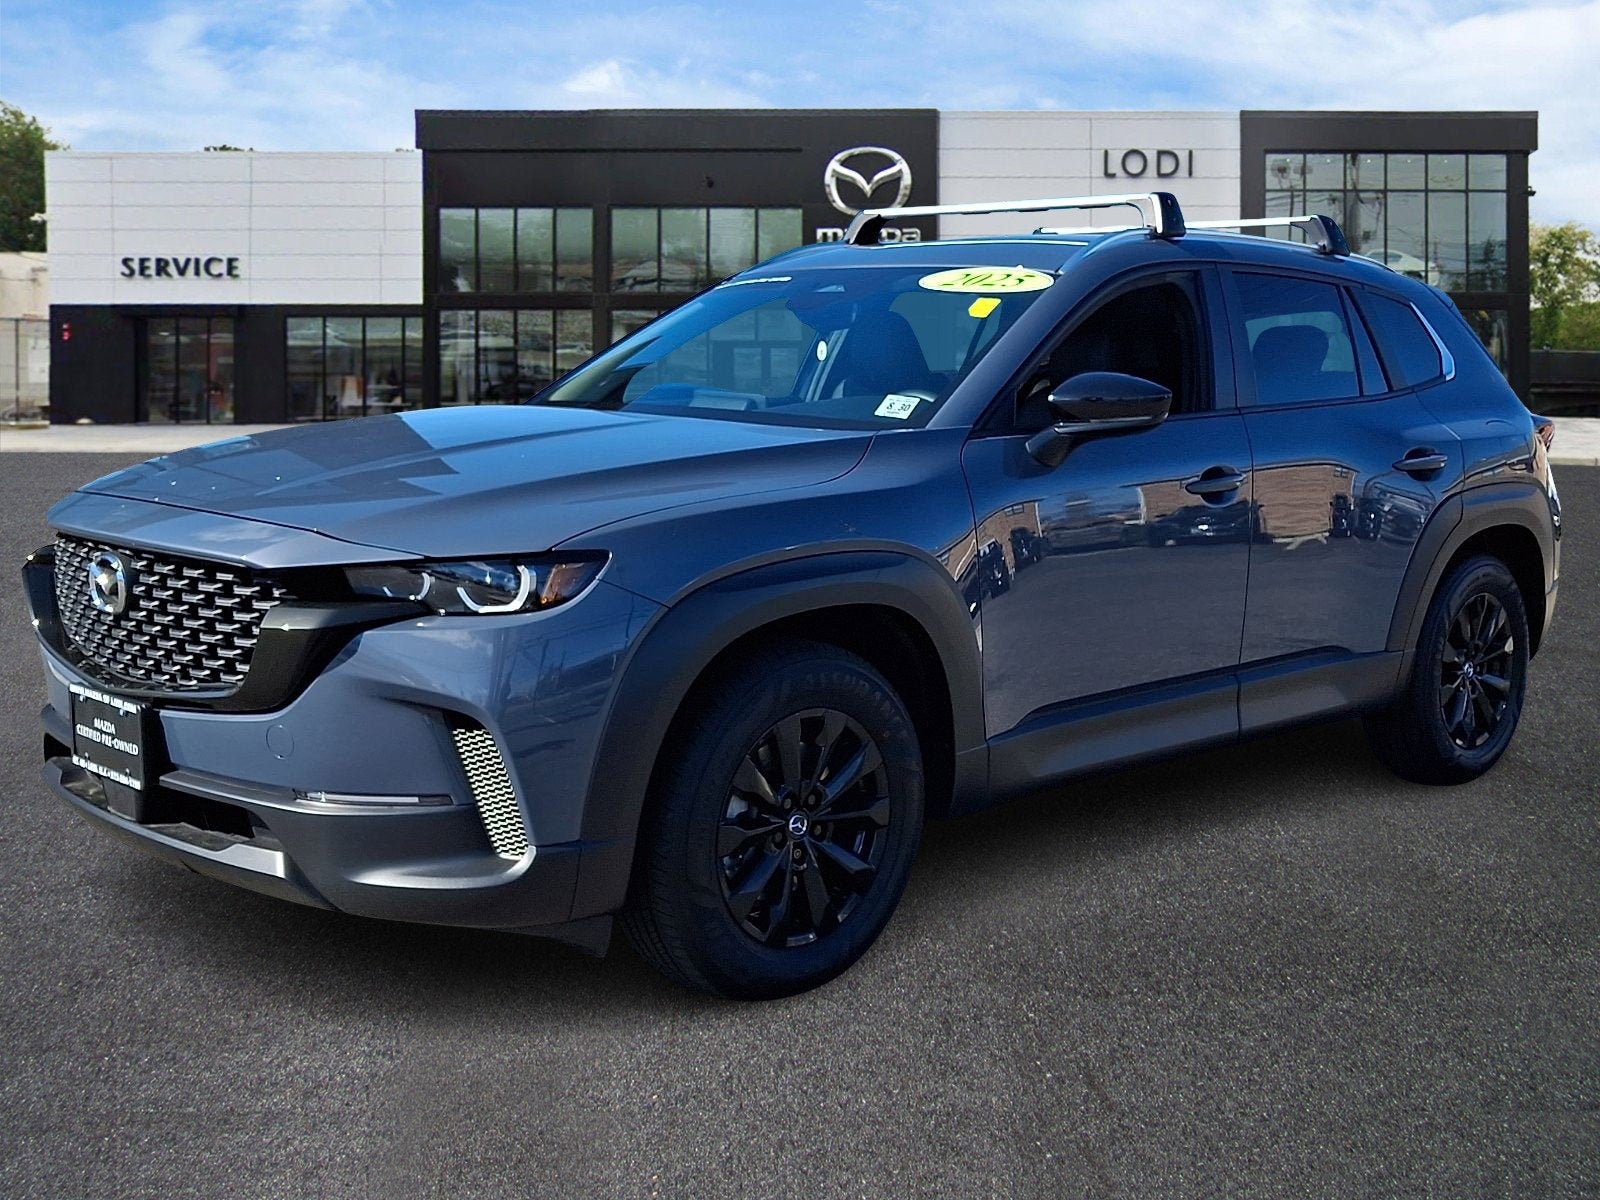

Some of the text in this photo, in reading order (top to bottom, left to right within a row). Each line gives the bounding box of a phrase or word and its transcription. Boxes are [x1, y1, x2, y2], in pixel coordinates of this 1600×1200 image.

[1103, 149, 1193, 178] LODI
[816, 227, 921, 242] mda
[120, 256, 240, 279] SERVICE
[936, 272, 1037, 288] 2025
[93, 717, 116, 735] MAZDA
[76, 723, 139, 756] CERTIFIED PRE-OWNED
